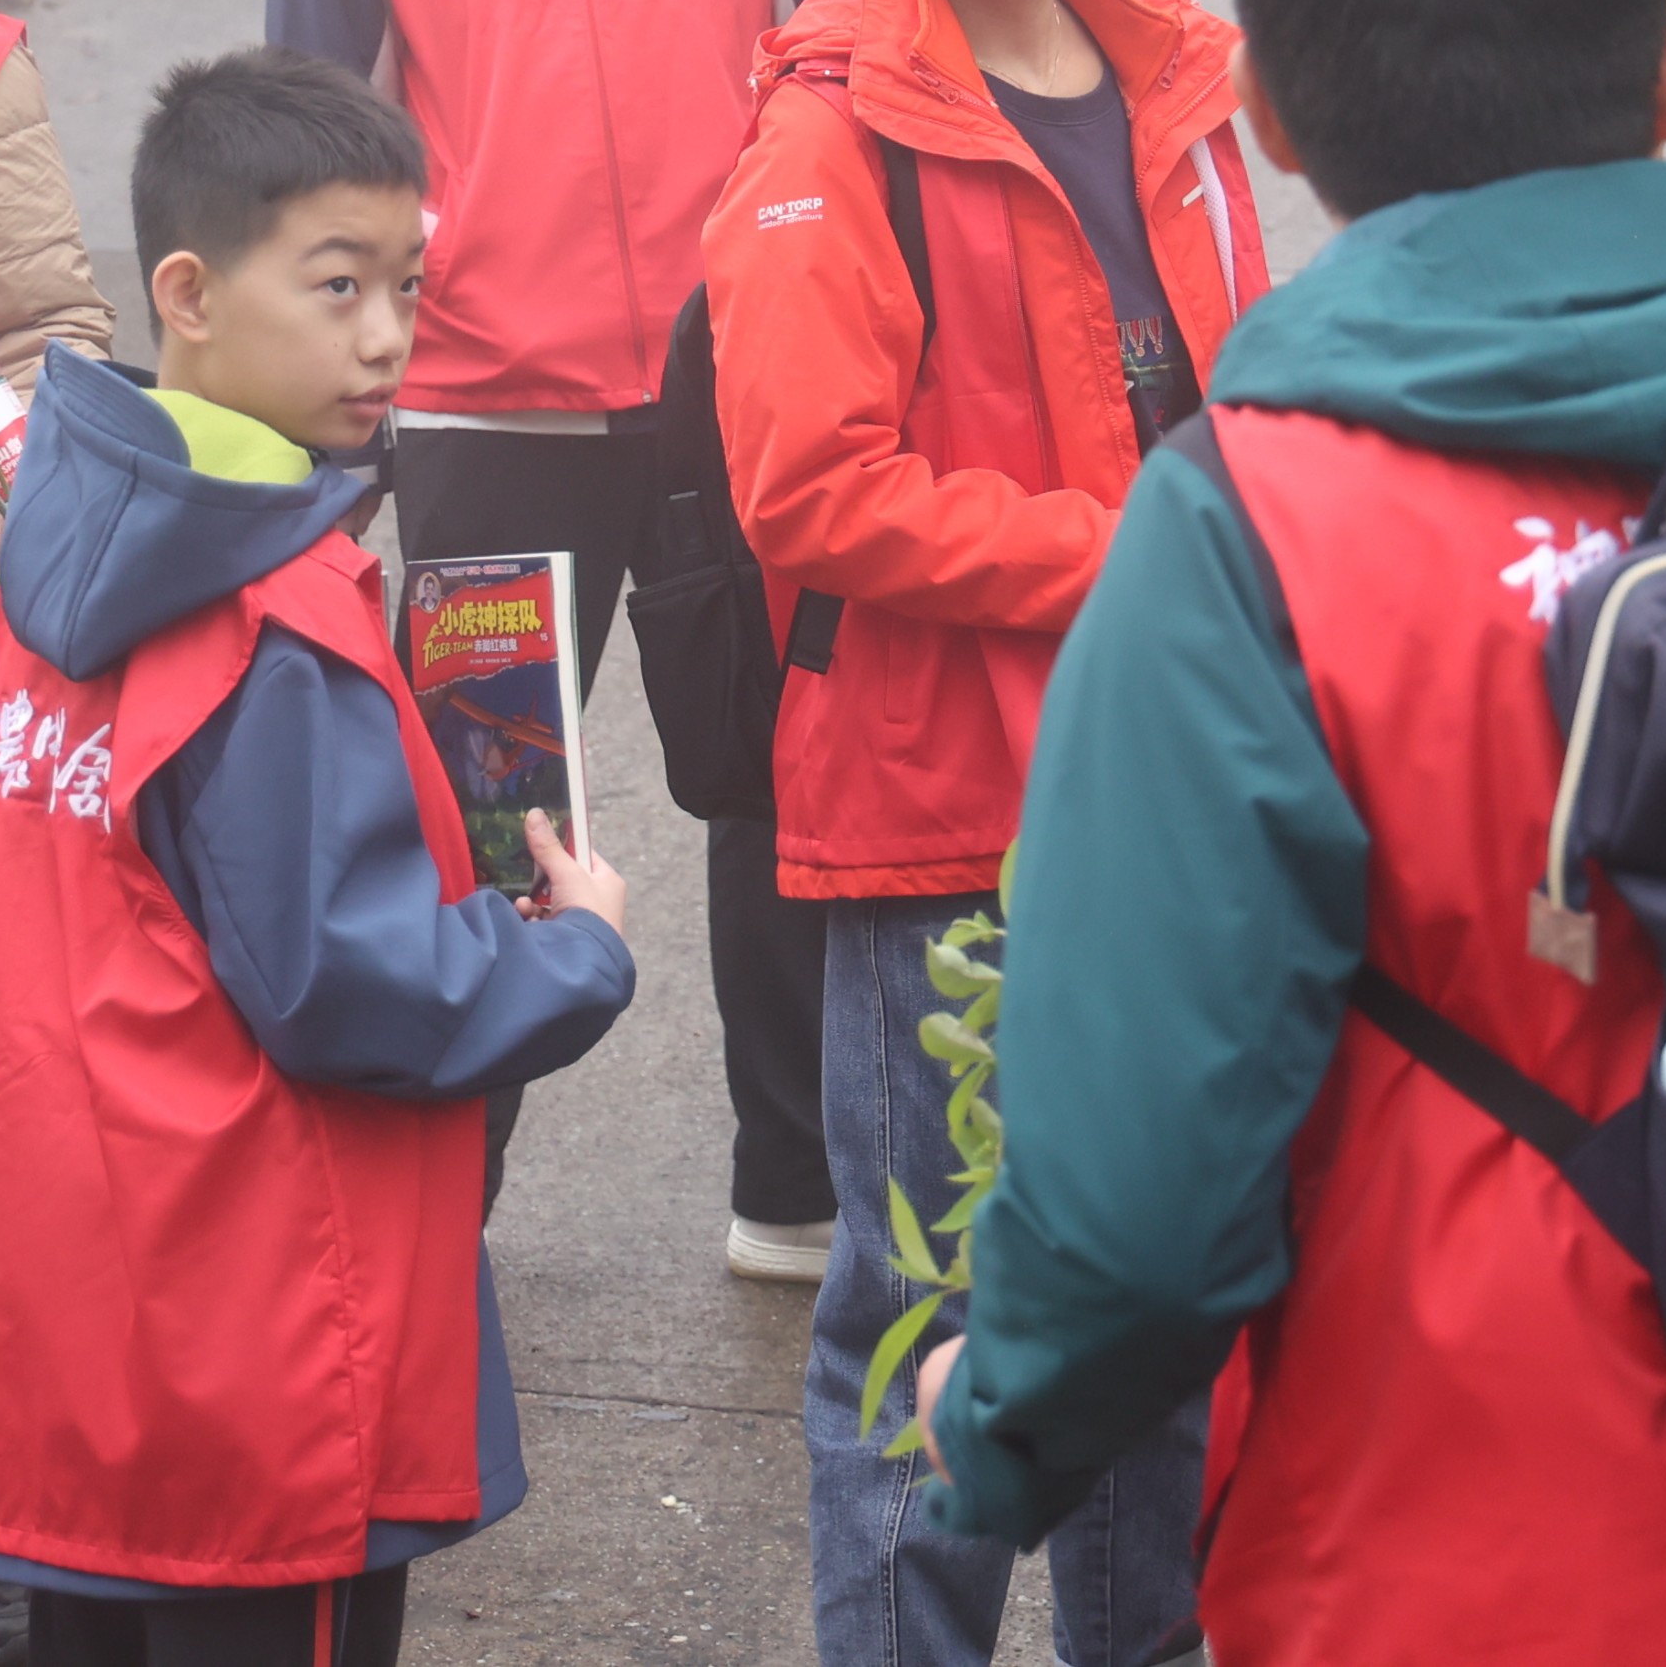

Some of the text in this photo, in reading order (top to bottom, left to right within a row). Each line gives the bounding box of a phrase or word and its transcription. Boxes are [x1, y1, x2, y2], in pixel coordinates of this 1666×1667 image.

[439, 599, 542, 636] 小虎神探队
